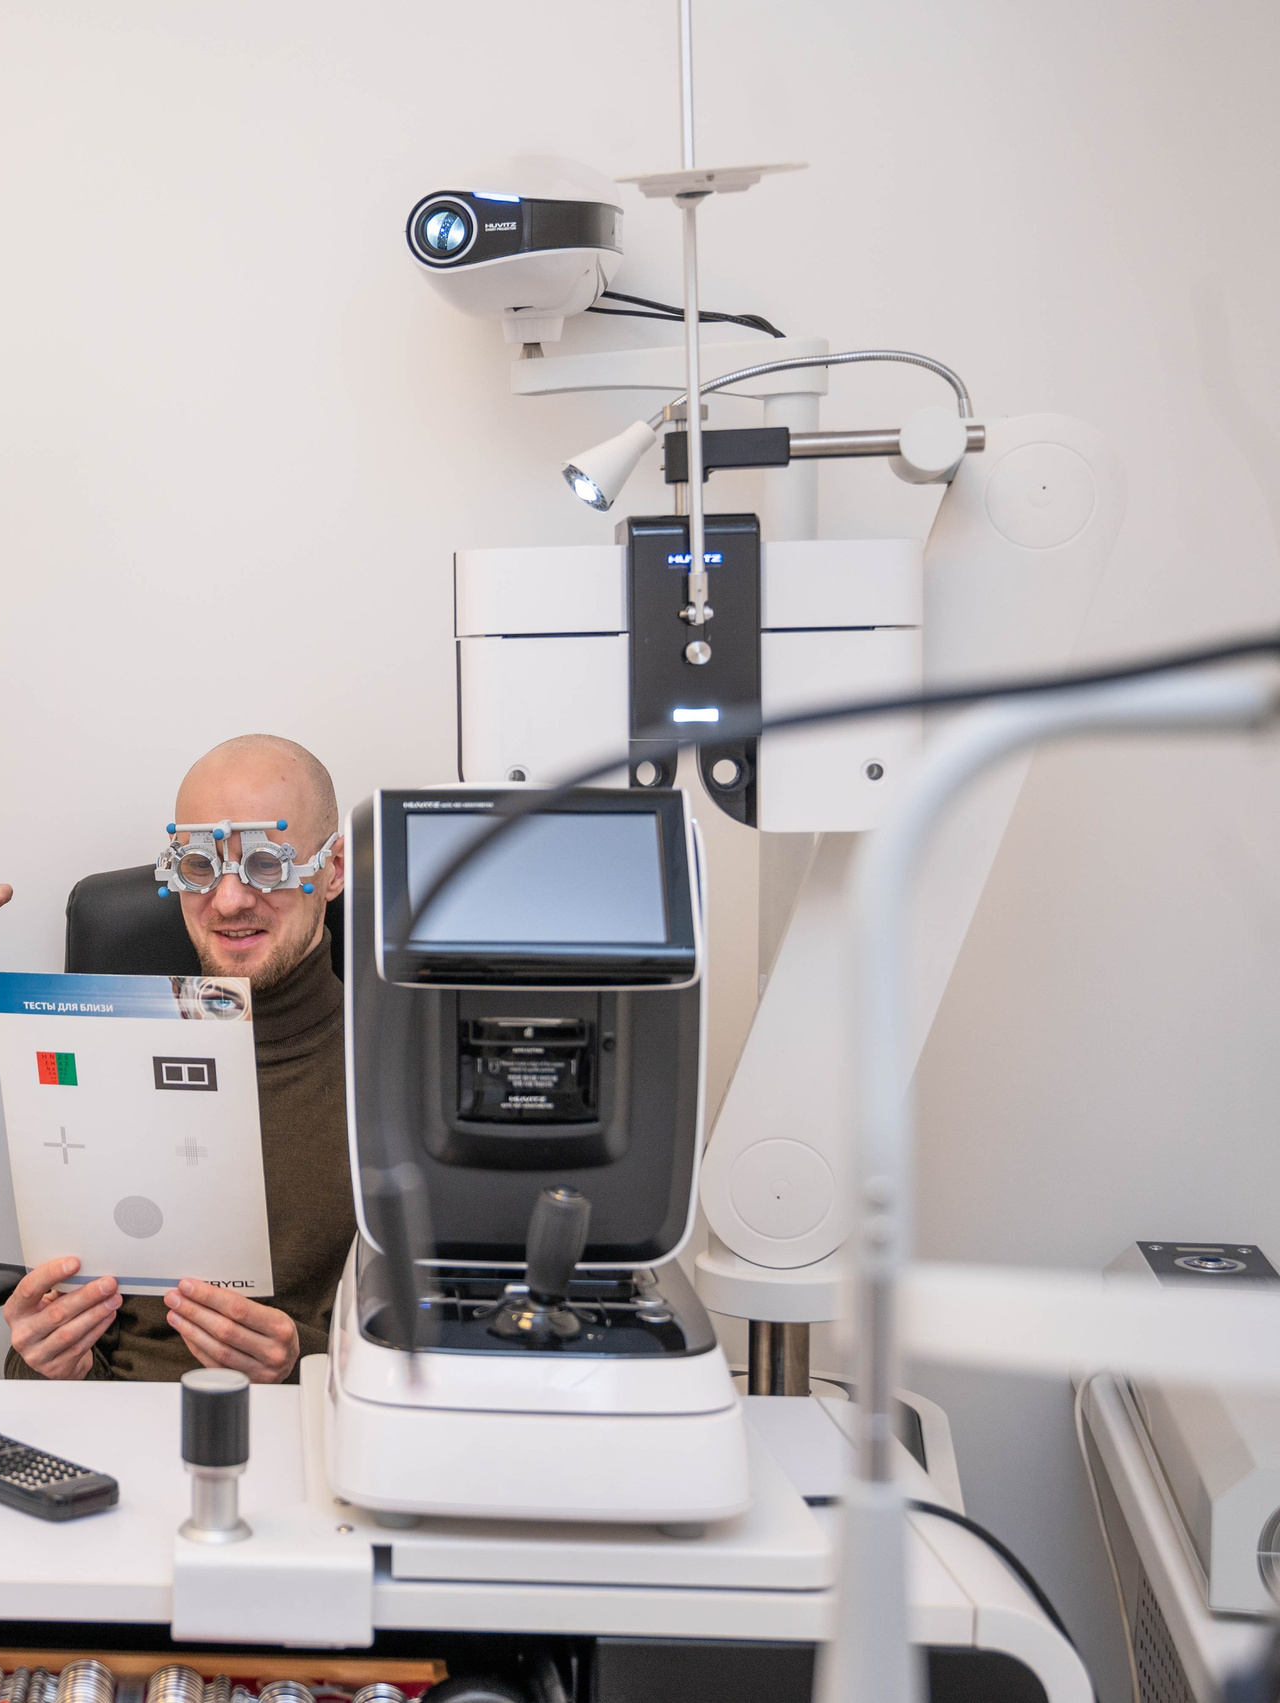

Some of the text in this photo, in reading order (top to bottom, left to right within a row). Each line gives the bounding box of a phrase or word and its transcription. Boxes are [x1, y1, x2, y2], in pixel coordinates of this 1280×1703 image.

[485, 221, 517, 229] HUVITZ
[668, 553, 722, 564] HUTZ
[23, 1001, 114, 1013] ТЕСТЫ ДЛЯ БЛИЗИ
